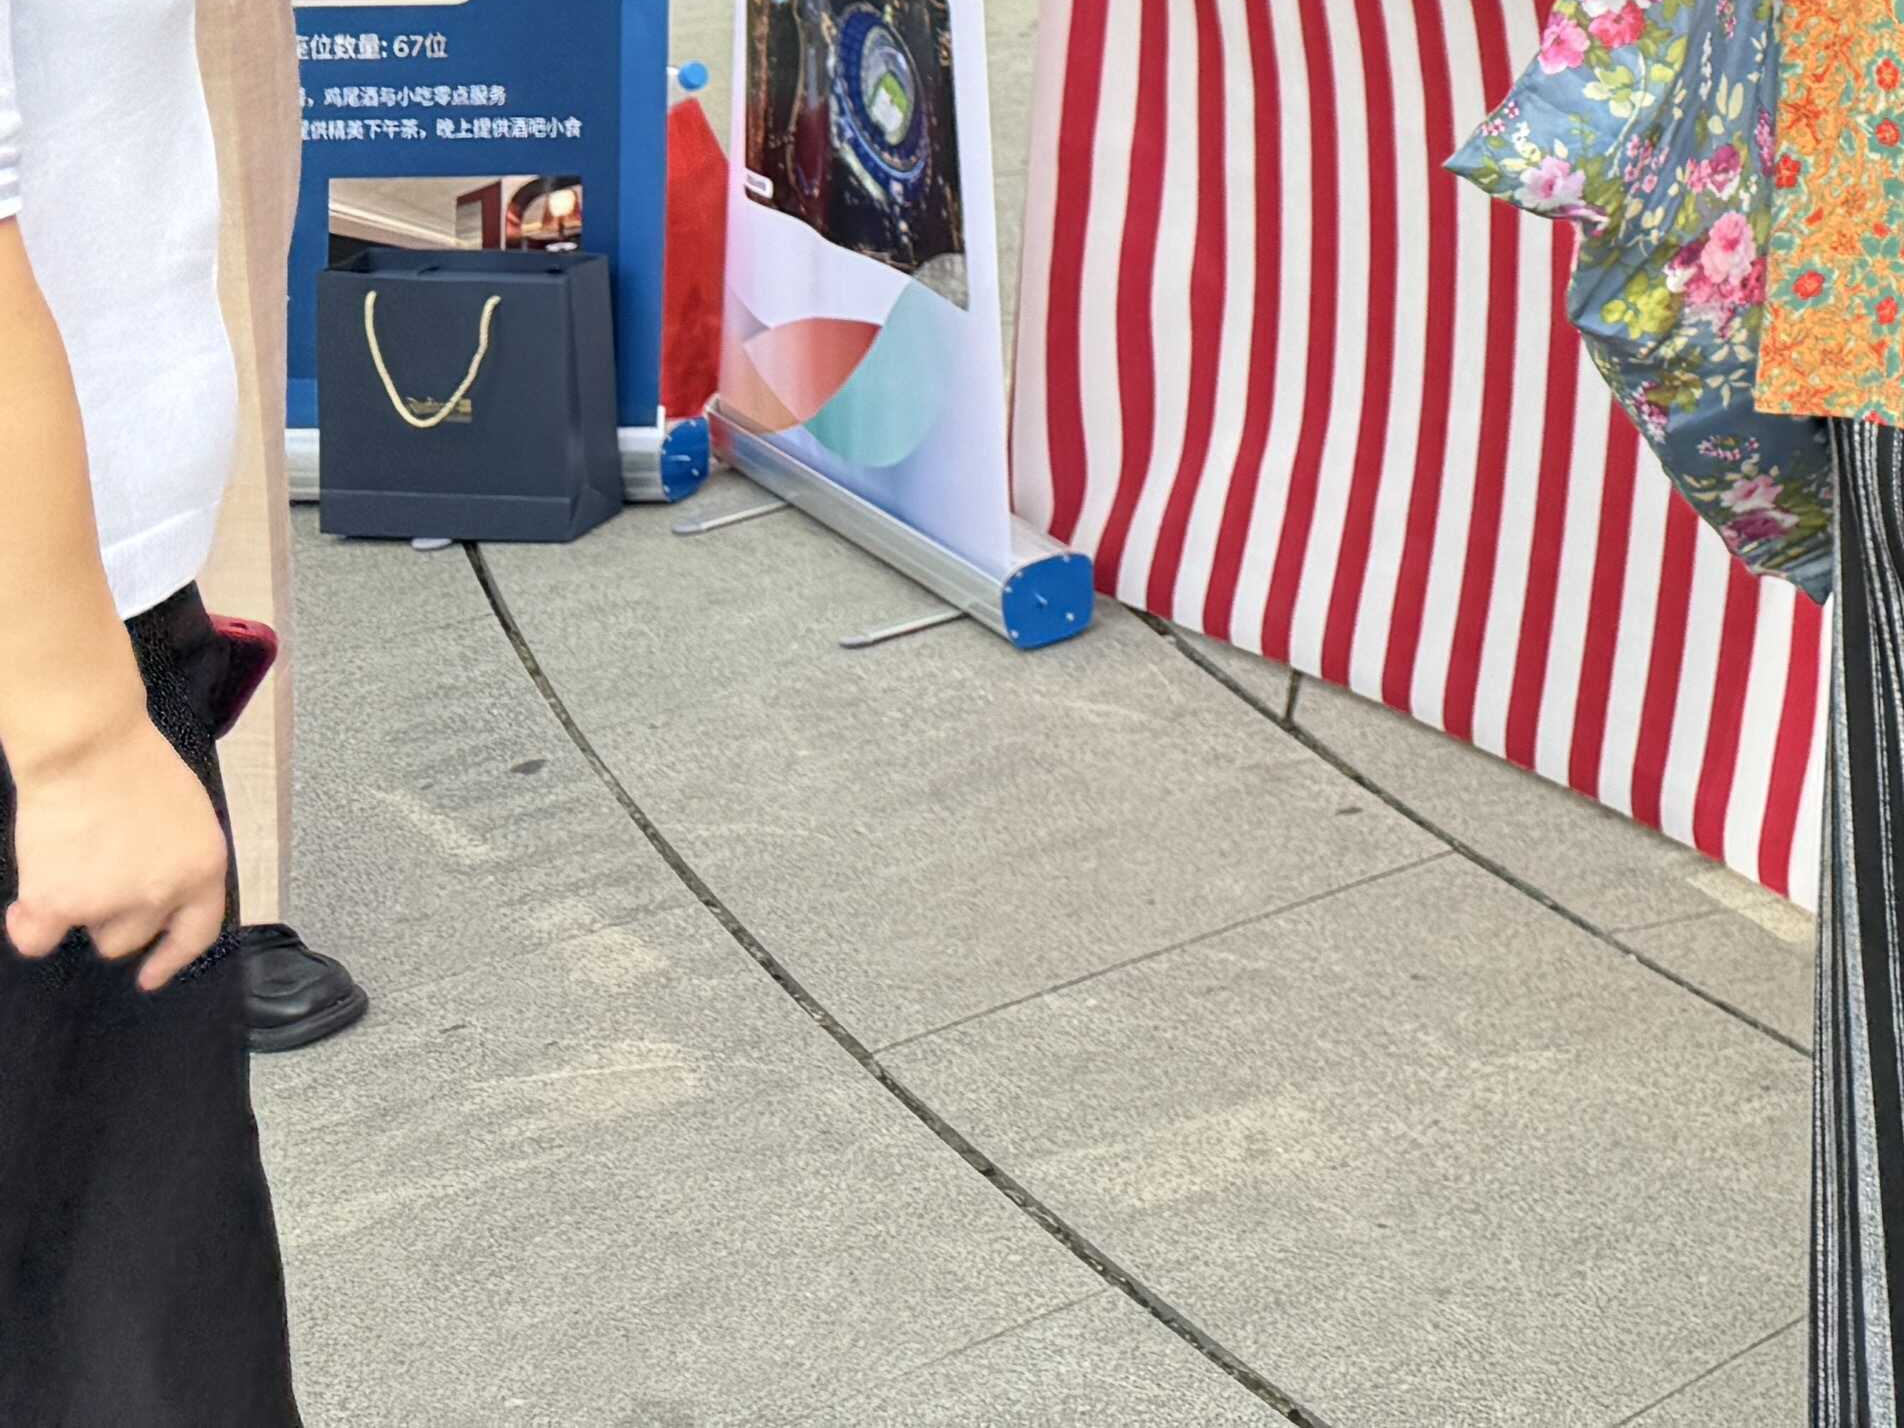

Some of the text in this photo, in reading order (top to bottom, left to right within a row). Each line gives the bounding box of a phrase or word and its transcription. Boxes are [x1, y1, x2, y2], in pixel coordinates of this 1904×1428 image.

[299, 84, 507, 108] ，鸡尾酒与小吃零点服务
